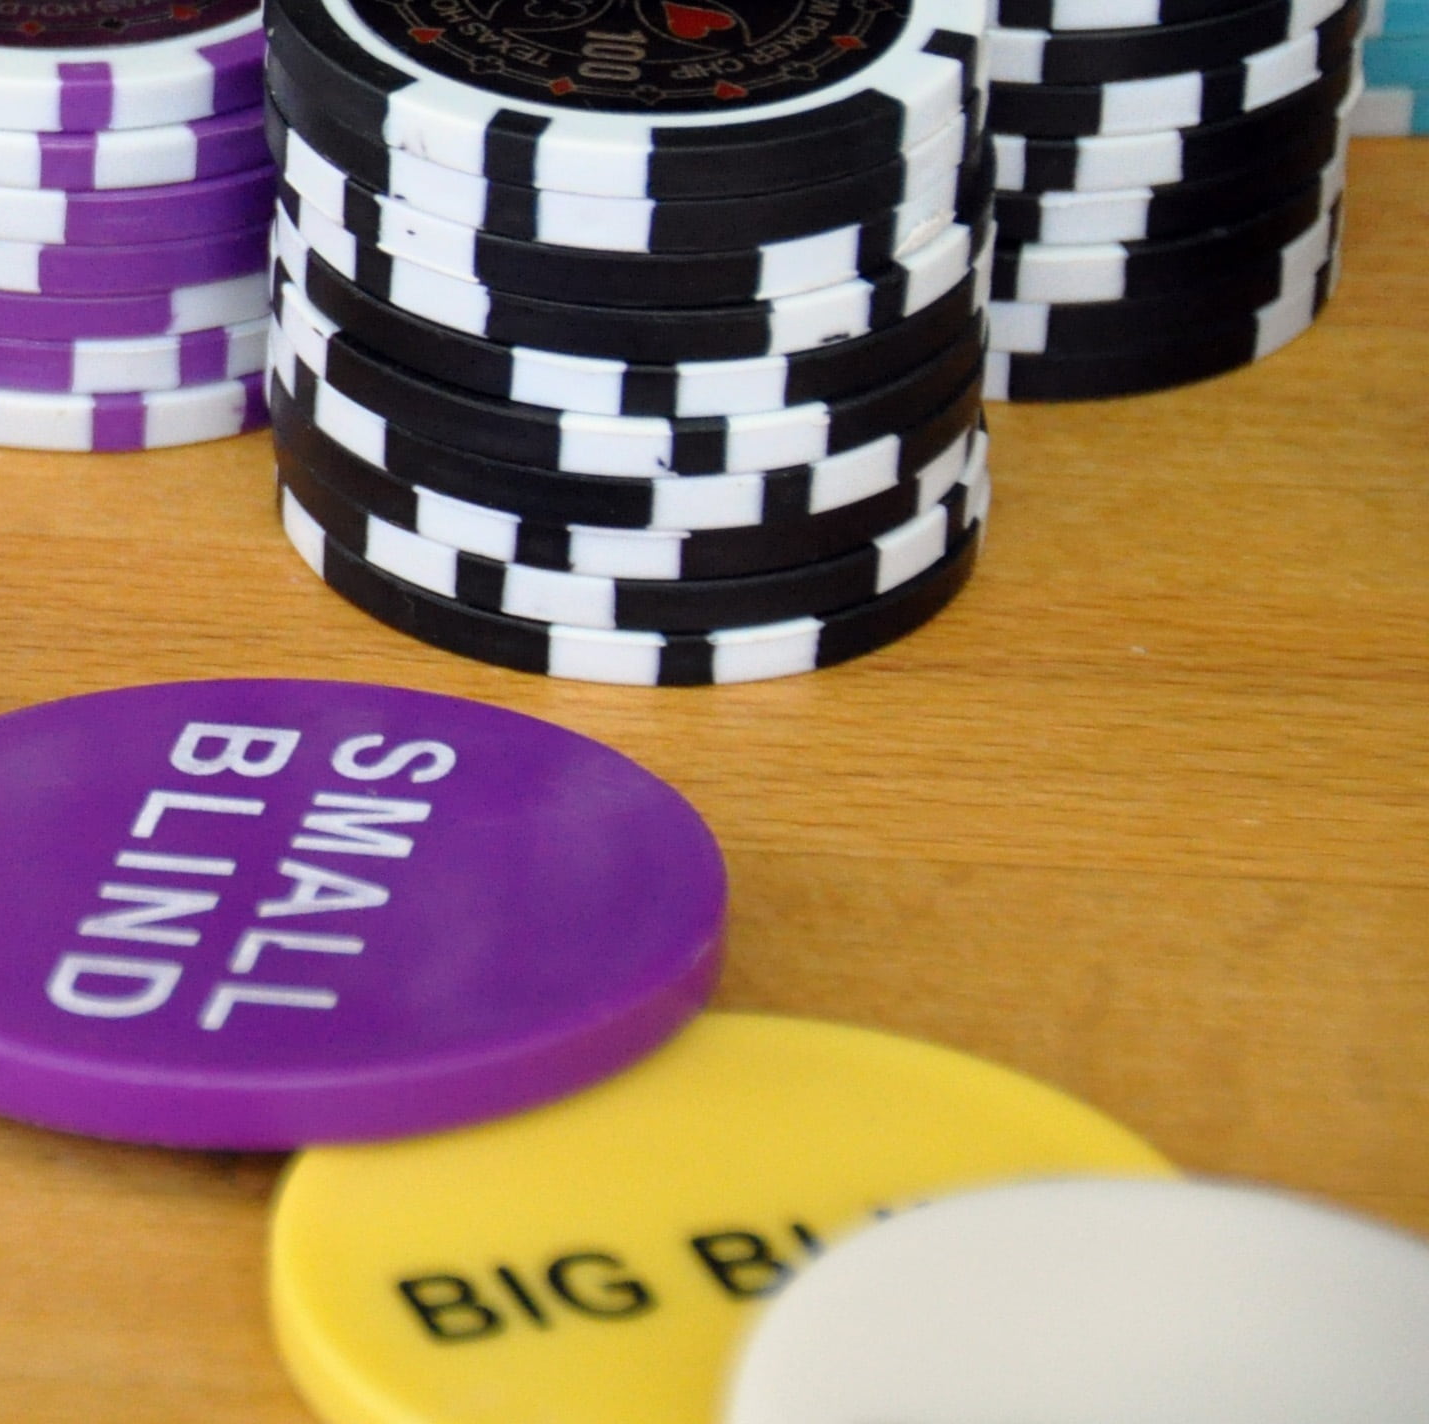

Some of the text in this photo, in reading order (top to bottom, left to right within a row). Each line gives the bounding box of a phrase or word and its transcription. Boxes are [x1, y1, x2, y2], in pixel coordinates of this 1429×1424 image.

[458, 20, 552, 69] TEXAS
[577, 29, 649, 82] 100
[743, 15, 831, 66] POKER
[670, 57, 745, 80] CHIP
[44, 721, 302, 1019] BLIND
[200, 733, 458, 1032] SMALL
[397, 1250, 660, 1344] BIG
